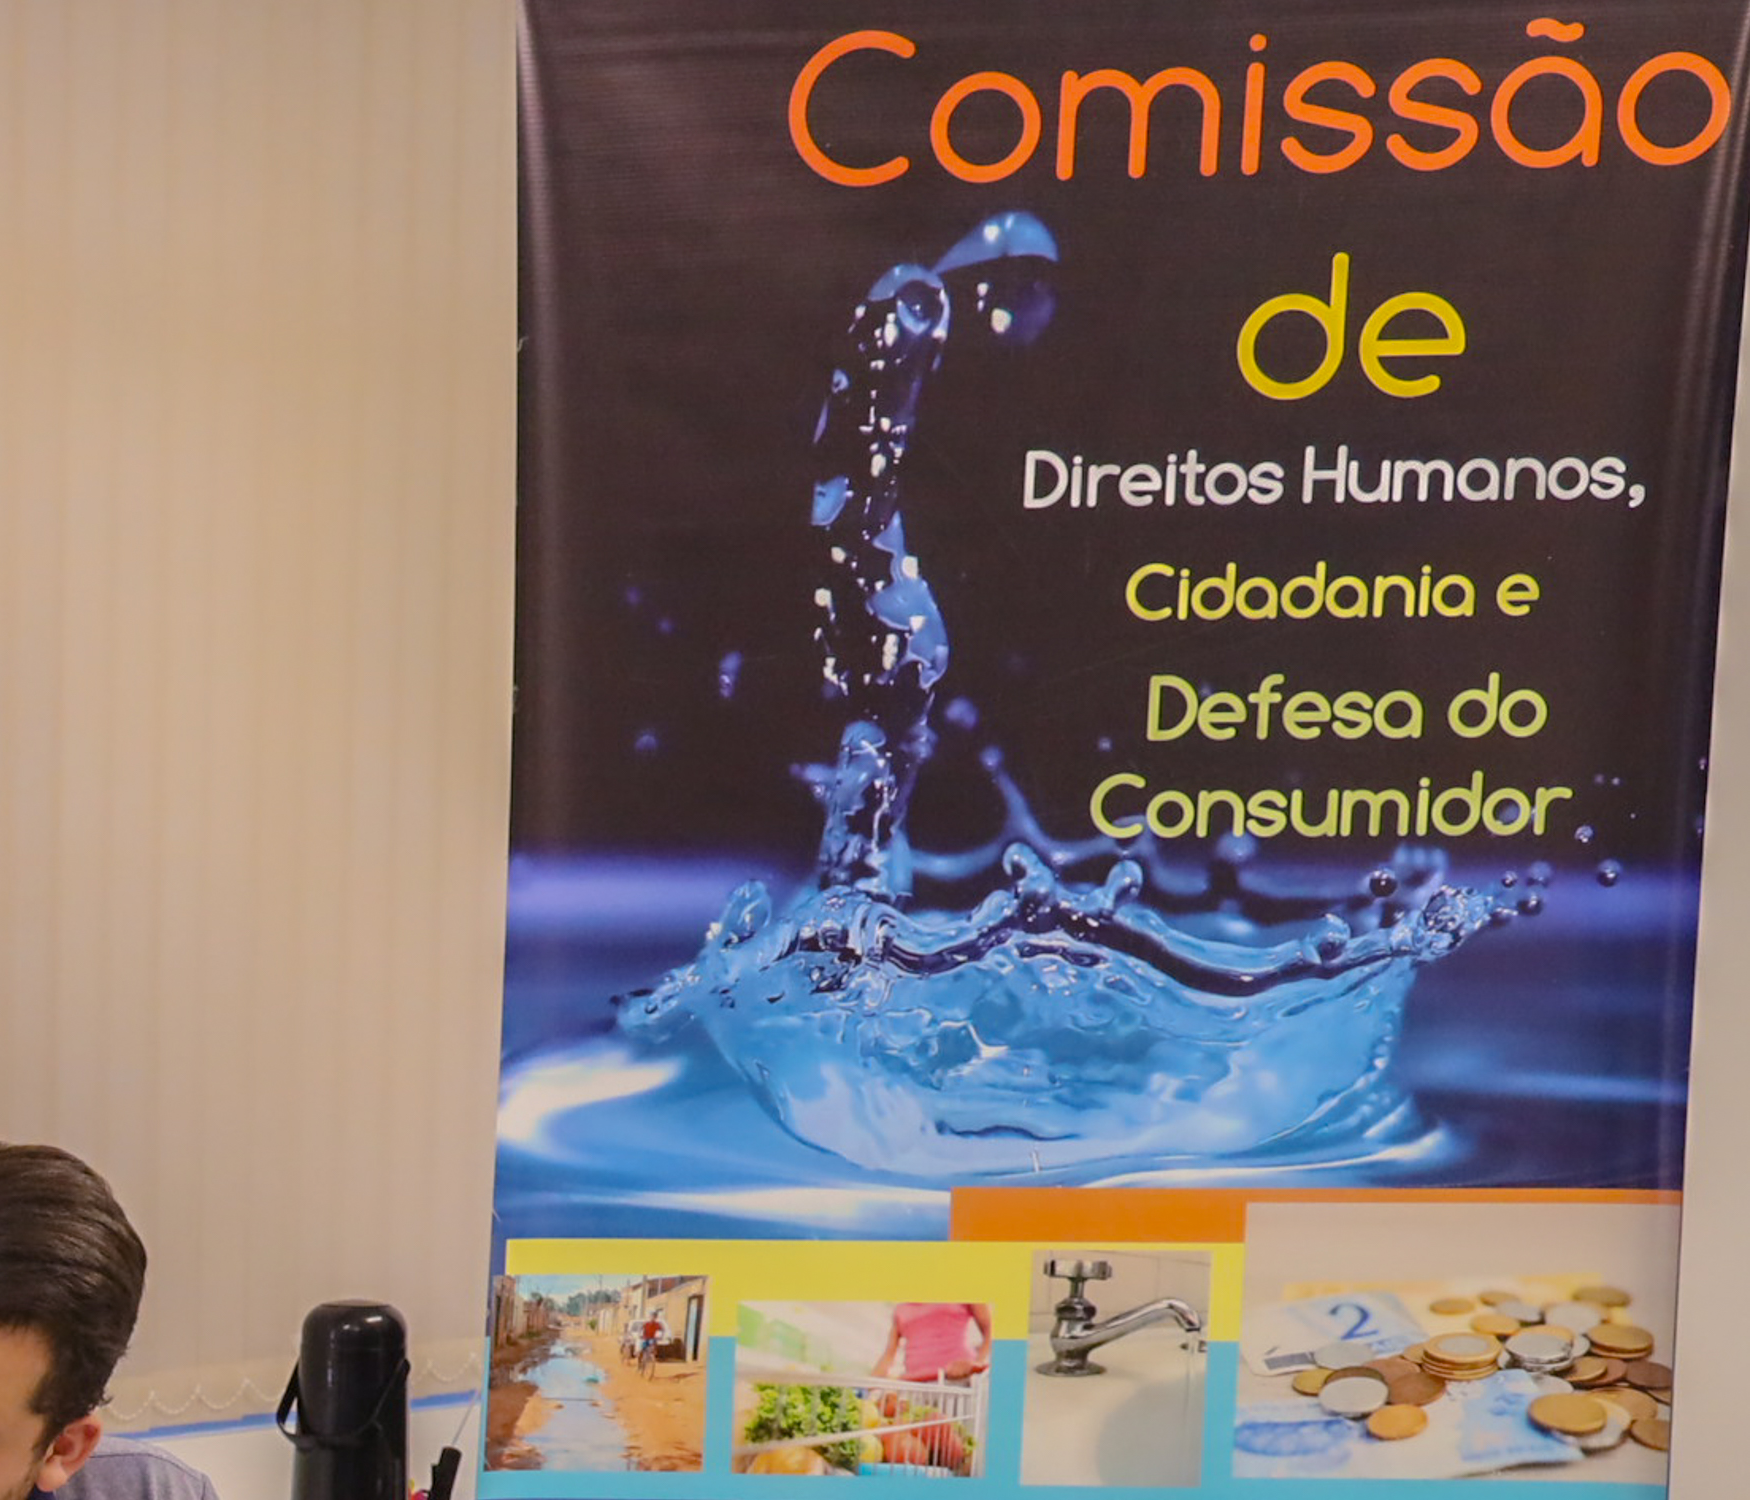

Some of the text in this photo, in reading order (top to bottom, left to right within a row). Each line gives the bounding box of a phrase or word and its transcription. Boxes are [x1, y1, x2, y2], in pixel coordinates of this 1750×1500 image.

[788, 18, 1732, 187] Comissão
[1236, 252, 1466, 400] de
[1023, 445, 1646, 509] Direitos Humanos,
[1125, 561, 1540, 621] Cidadania e
[1146, 672, 1548, 741] Defesa do
[1090, 771, 1573, 838] Consumidor
